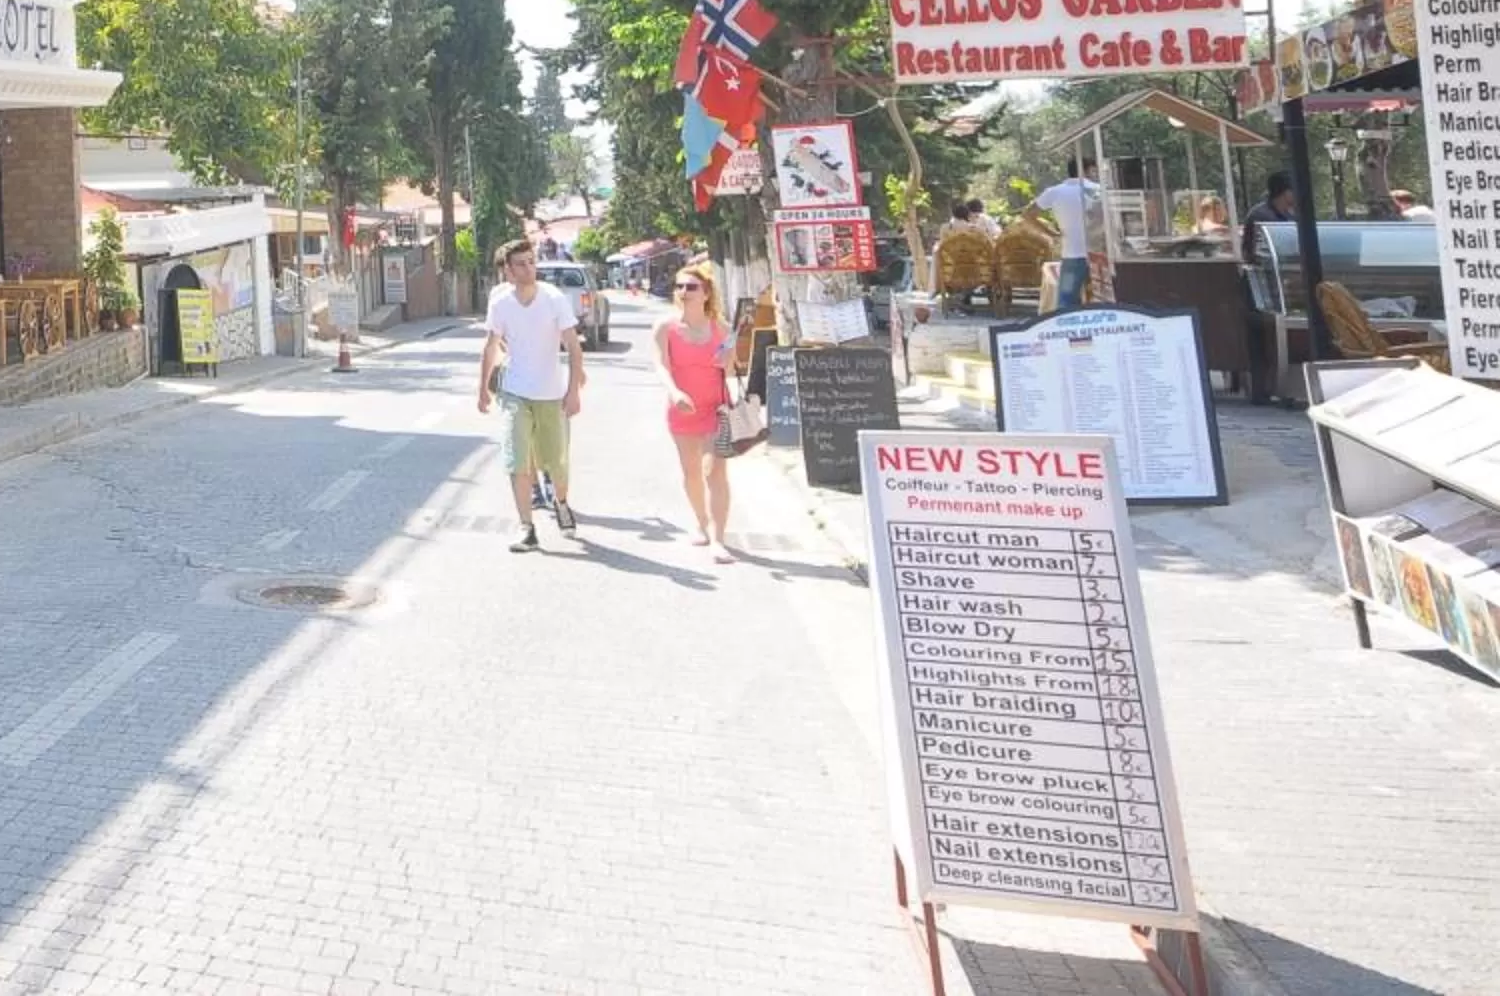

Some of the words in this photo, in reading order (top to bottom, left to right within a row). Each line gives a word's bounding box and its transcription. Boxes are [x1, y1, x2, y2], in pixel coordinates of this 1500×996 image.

[896, 36, 1065, 77] Restaurant
[1079, 32, 1151, 68] Cafe
[1160, 29, 1183, 65] &
[1188, 28, 1245, 64] Bar
[1434, 55, 1481, 74] Perm
[1436, 81, 1472, 103] Hair
[1445, 169, 1472, 195] Eye
[1449, 198, 1487, 220] Hair
[1452, 227, 1488, 249] Nail
[878, 446, 964, 473] NEW
[977, 449, 1104, 479] STYLE
[885, 476, 949, 492] Coiffeur
[964, 479, 1017, 495] Tattoo
[1033, 483, 1103, 500] Piercing
[907, 495, 1001, 512] Permenant
[1007, 499, 1055, 517] make
[1061, 505, 1084, 520] up
[894, 525, 980, 545] Haircut
[988, 533, 1039, 547] man
[897, 547, 981, 566] Haircut
[988, 555, 1074, 571] woman
[901, 570, 975, 589] Shave
[903, 593, 951, 611] Hair
[958, 598, 1023, 616] wash
[907, 616, 966, 636] Blow
[975, 621, 1016, 643] Dry
[910, 641, 1022, 664] Colouring
[1030, 650, 1090, 667] From
[912, 665, 1026, 687] Highlights
[1035, 674, 1093, 692] From
[916, 688, 965, 707] Hair
[973, 692, 1077, 719] braiding
[919, 712, 1033, 737] Manicure
[922, 737, 1033, 761] Pedicure
[925, 763, 968, 781] Eye
[976, 767, 1034, 785] brow
[1043, 775, 1109, 793] pluck
[928, 785, 963, 803] Eye
[969, 789, 1016, 806] brow
[1021, 797, 1114, 819] colouring
[932, 813, 979, 833] Hair
[987, 823, 1119, 848] extensions
[936, 837, 981, 858] Nail
[988, 847, 1123, 874] extensions
[939, 863, 983, 882] Deep
[988, 869, 1072, 895] cleansing
[1078, 878, 1126, 898] facial
